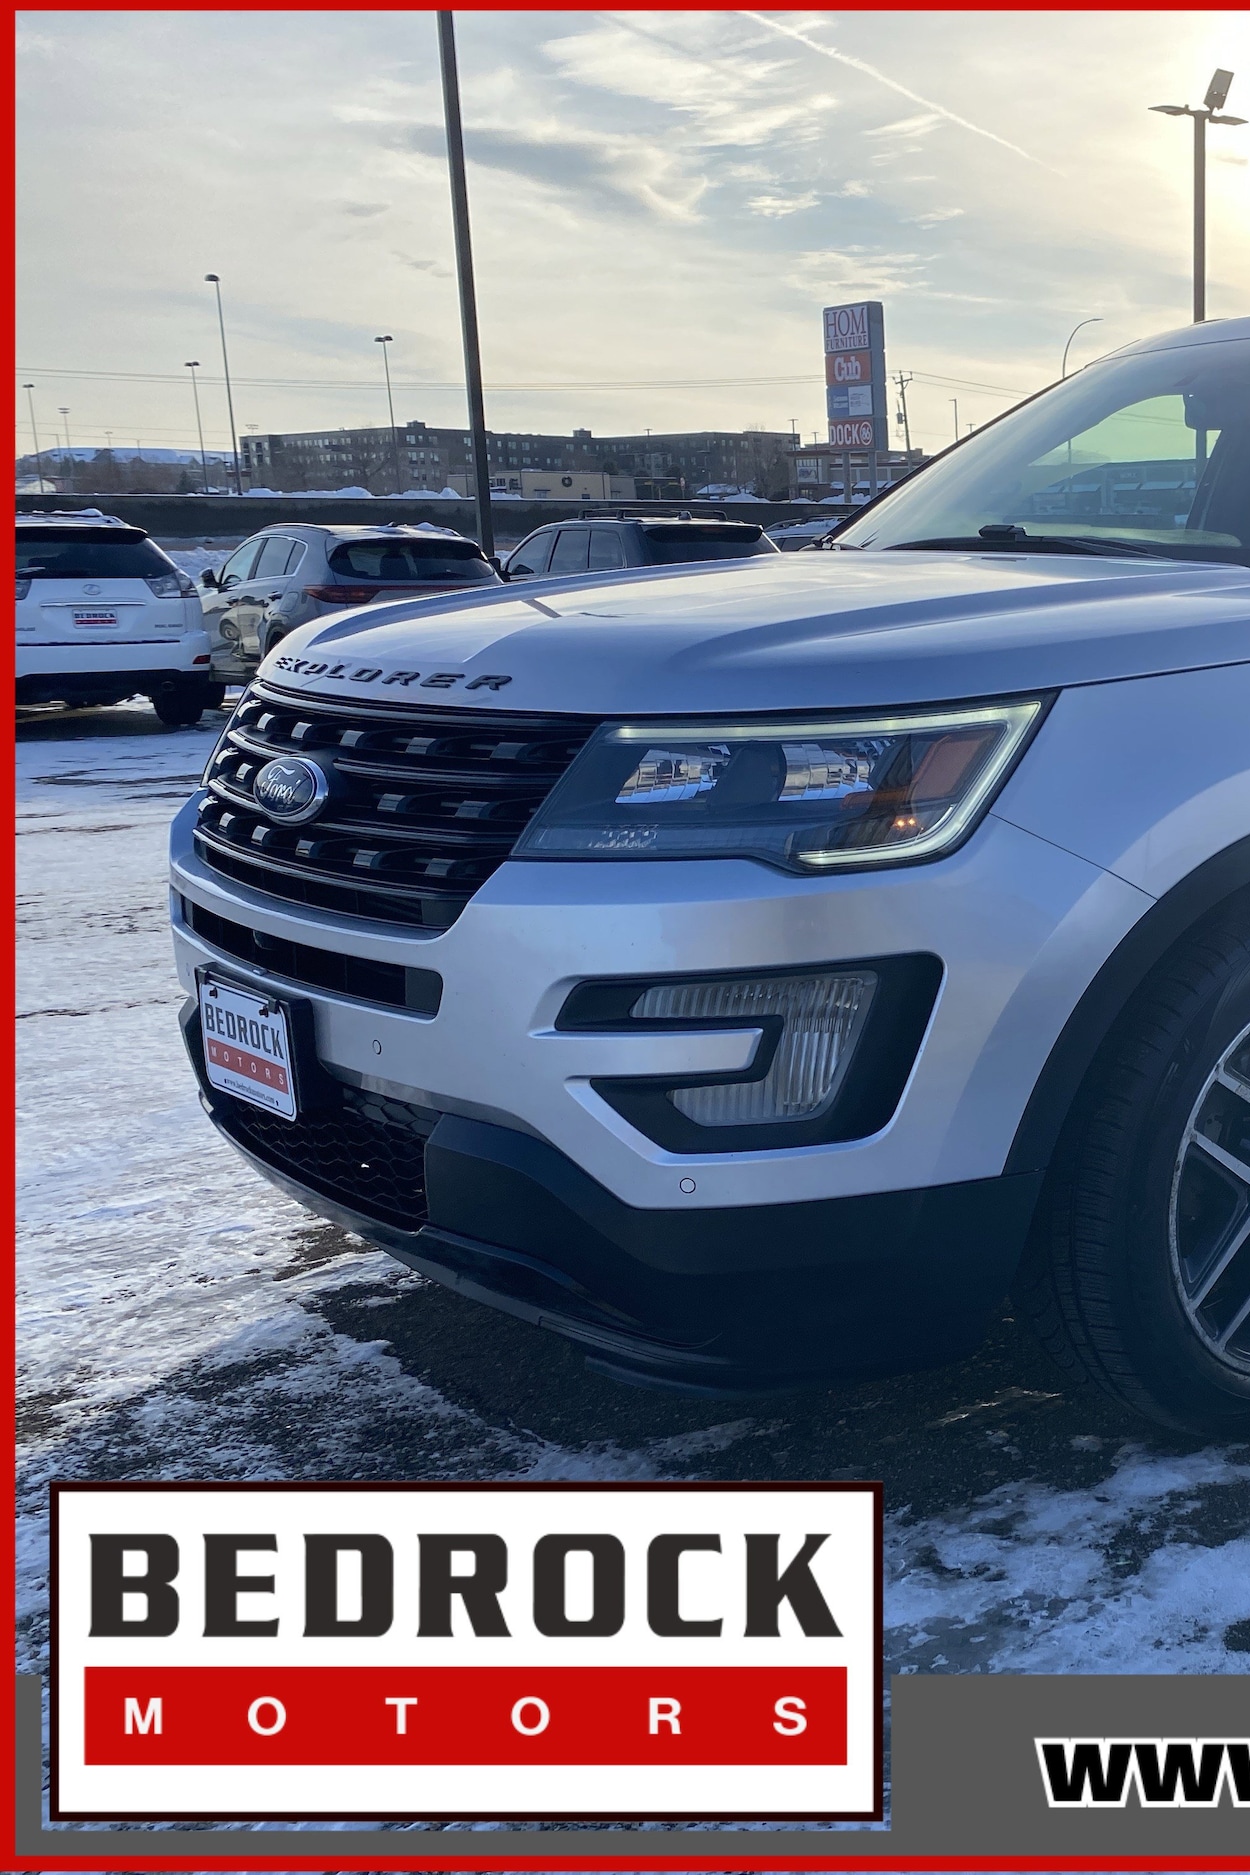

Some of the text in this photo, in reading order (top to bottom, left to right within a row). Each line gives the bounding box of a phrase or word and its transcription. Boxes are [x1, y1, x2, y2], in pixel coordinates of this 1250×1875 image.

[825, 308, 867, 338] HOM
[826, 335, 868, 350] FURNITURE
[834, 356, 862, 381] Cub
[830, 424, 860, 446] DOCK
[273, 657, 513, 691] EXPLORER
[260, 765, 301, 805] Ford
[204, 1002, 285, 1060] BEDROCK
[210, 1045, 284, 1086] MOTORS
